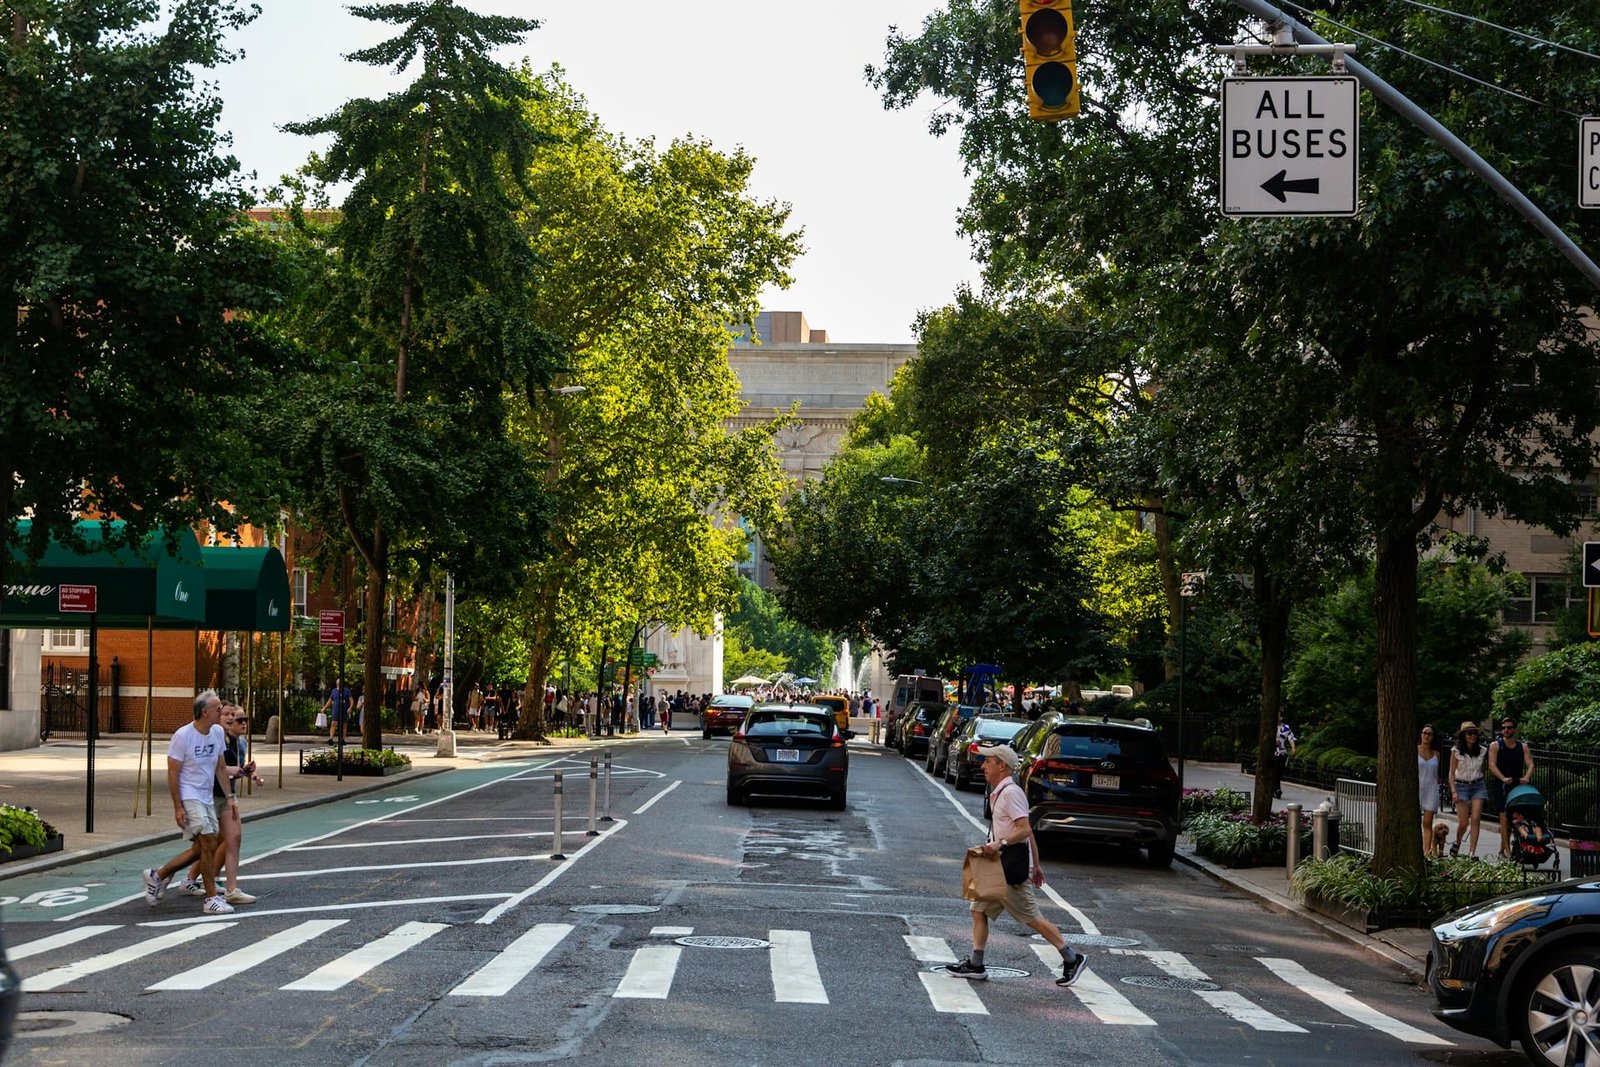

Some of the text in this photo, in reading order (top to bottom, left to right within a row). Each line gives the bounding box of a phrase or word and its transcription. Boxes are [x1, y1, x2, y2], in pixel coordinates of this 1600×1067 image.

[1256, 90, 1325, 119] ALL
[1232, 129, 1347, 159] BUSES
[174, 581, 189, 602] One
[194, 744, 215, 756] EA7
